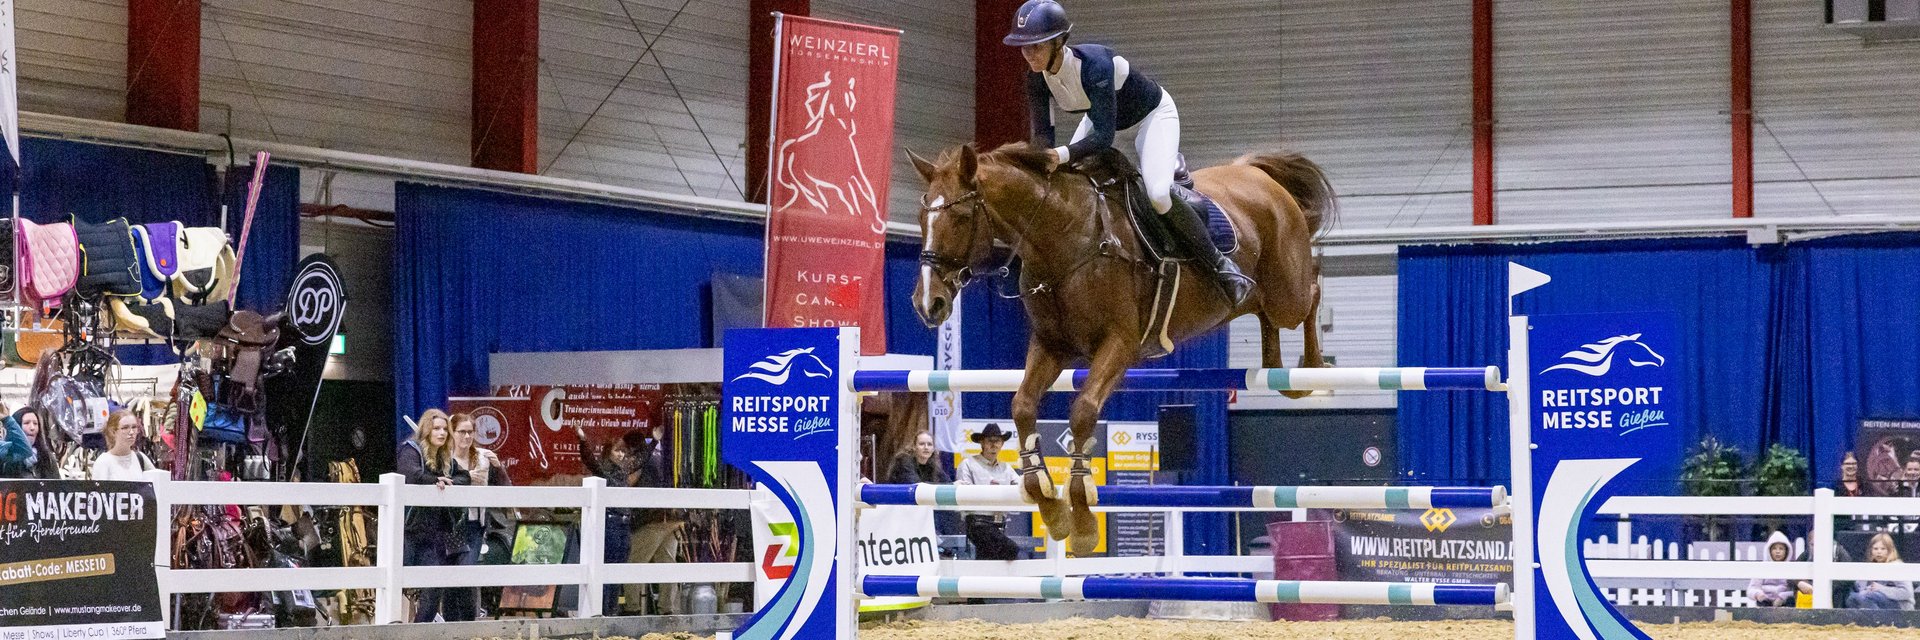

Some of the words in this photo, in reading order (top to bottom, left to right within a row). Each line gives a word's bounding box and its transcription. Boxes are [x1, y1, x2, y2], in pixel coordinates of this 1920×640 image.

[790, 35, 890, 59] WEINZIERL
[733, 396, 830, 412] REITSPORT
[1542, 387, 1663, 407] REITSPORT
[733, 417, 788, 432] MESSE
[794, 416, 830, 434] Gießen
[1543, 410, 1612, 429] MESSE
[1619, 409, 1665, 429] Gießen
[0, 492, 17, 521] G
[25, 491, 144, 521] MAKEOVER
[5, 522, 26, 546] für
[28, 520, 100, 543] Pferdefreunde
[66, 557, 106, 573] MESSE10
[1379, 561, 1425, 570] SPEZIALIST
[20, 606, 46, 616] Gelände
[54, 604, 141, 616] www.mustangmakeover.de
[3, 631, 25, 640] Messe
[32, 629, 54, 640] Shows
[63, 628, 86, 639] Liberty
[88, 627, 104, 638] Cup
[129, 625, 147, 635] Pferd
